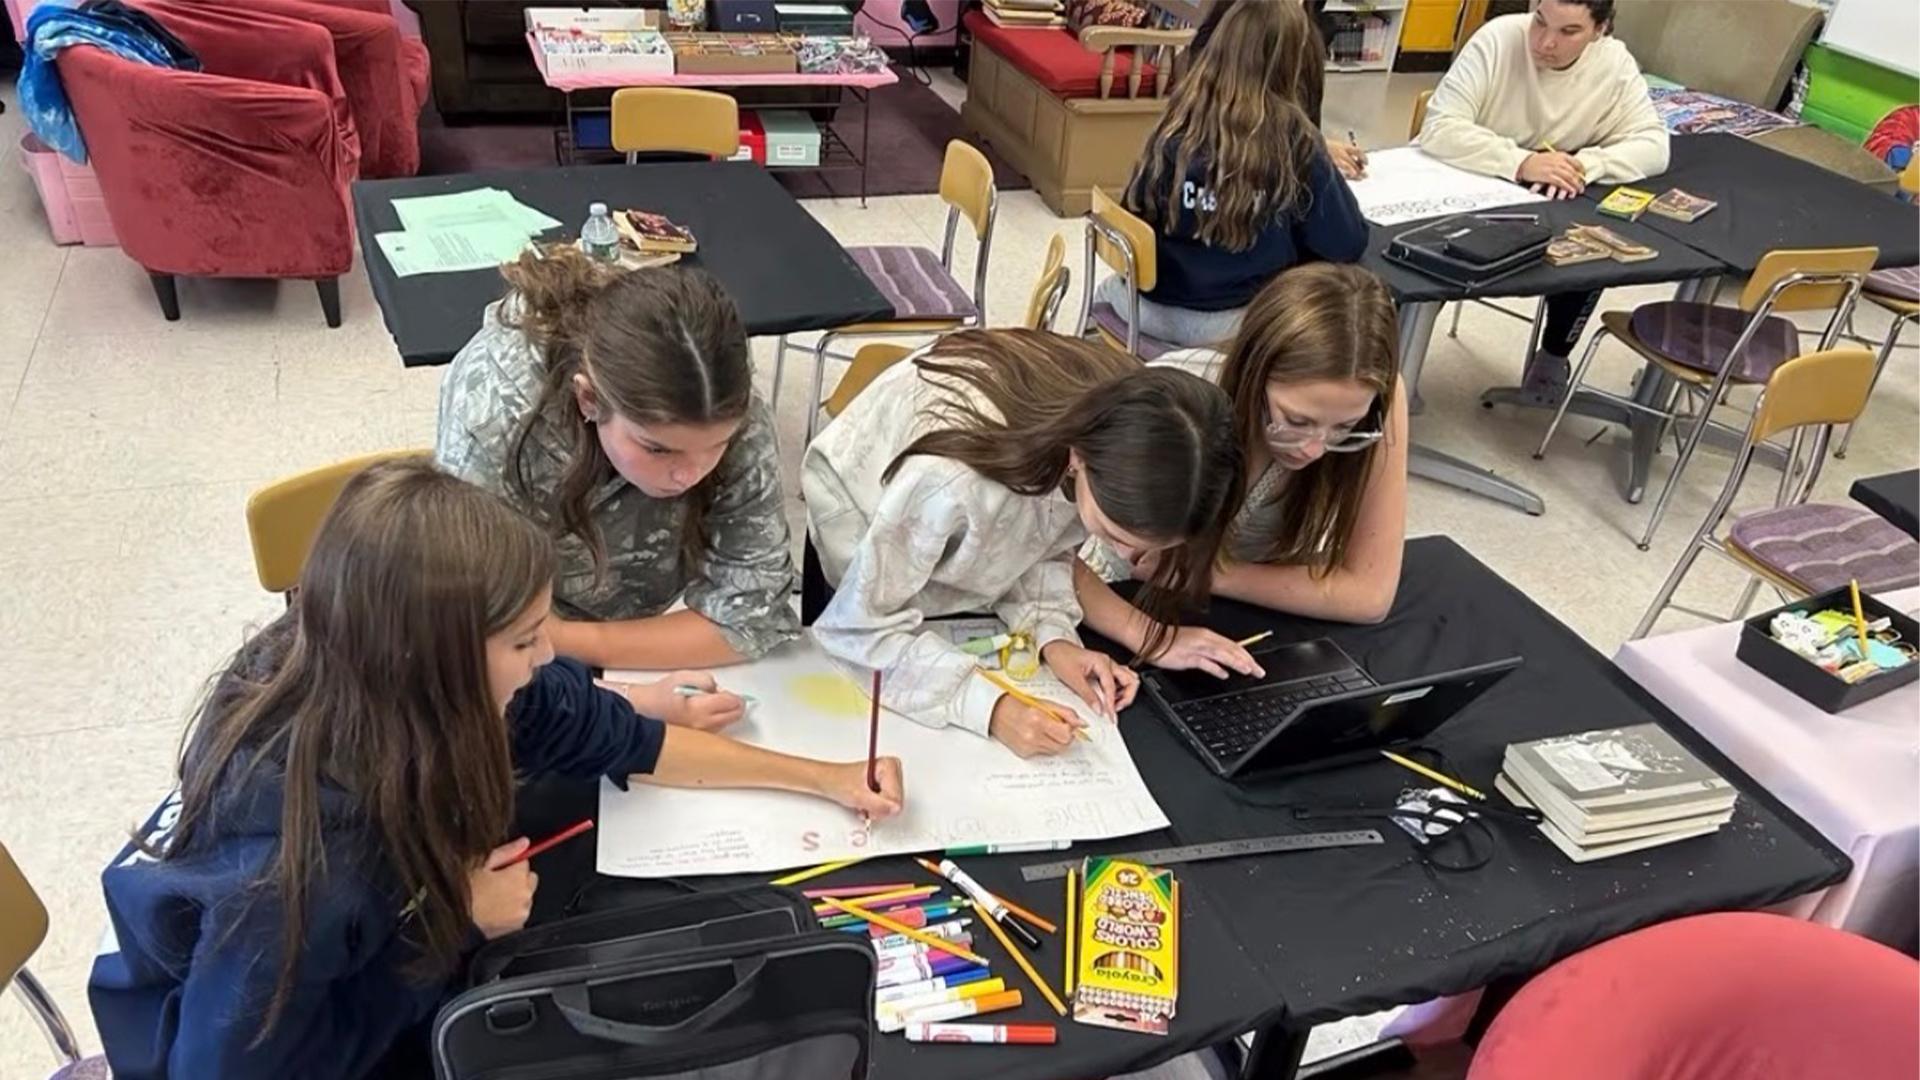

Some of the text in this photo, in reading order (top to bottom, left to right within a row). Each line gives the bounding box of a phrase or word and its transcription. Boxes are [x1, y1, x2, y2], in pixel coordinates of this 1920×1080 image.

[1119, 872, 1140, 885] 24
[1096, 918, 1148, 938] WORLD
[1094, 930, 1161, 950] COLORS
[1096, 969, 1157, 987] Crayola
